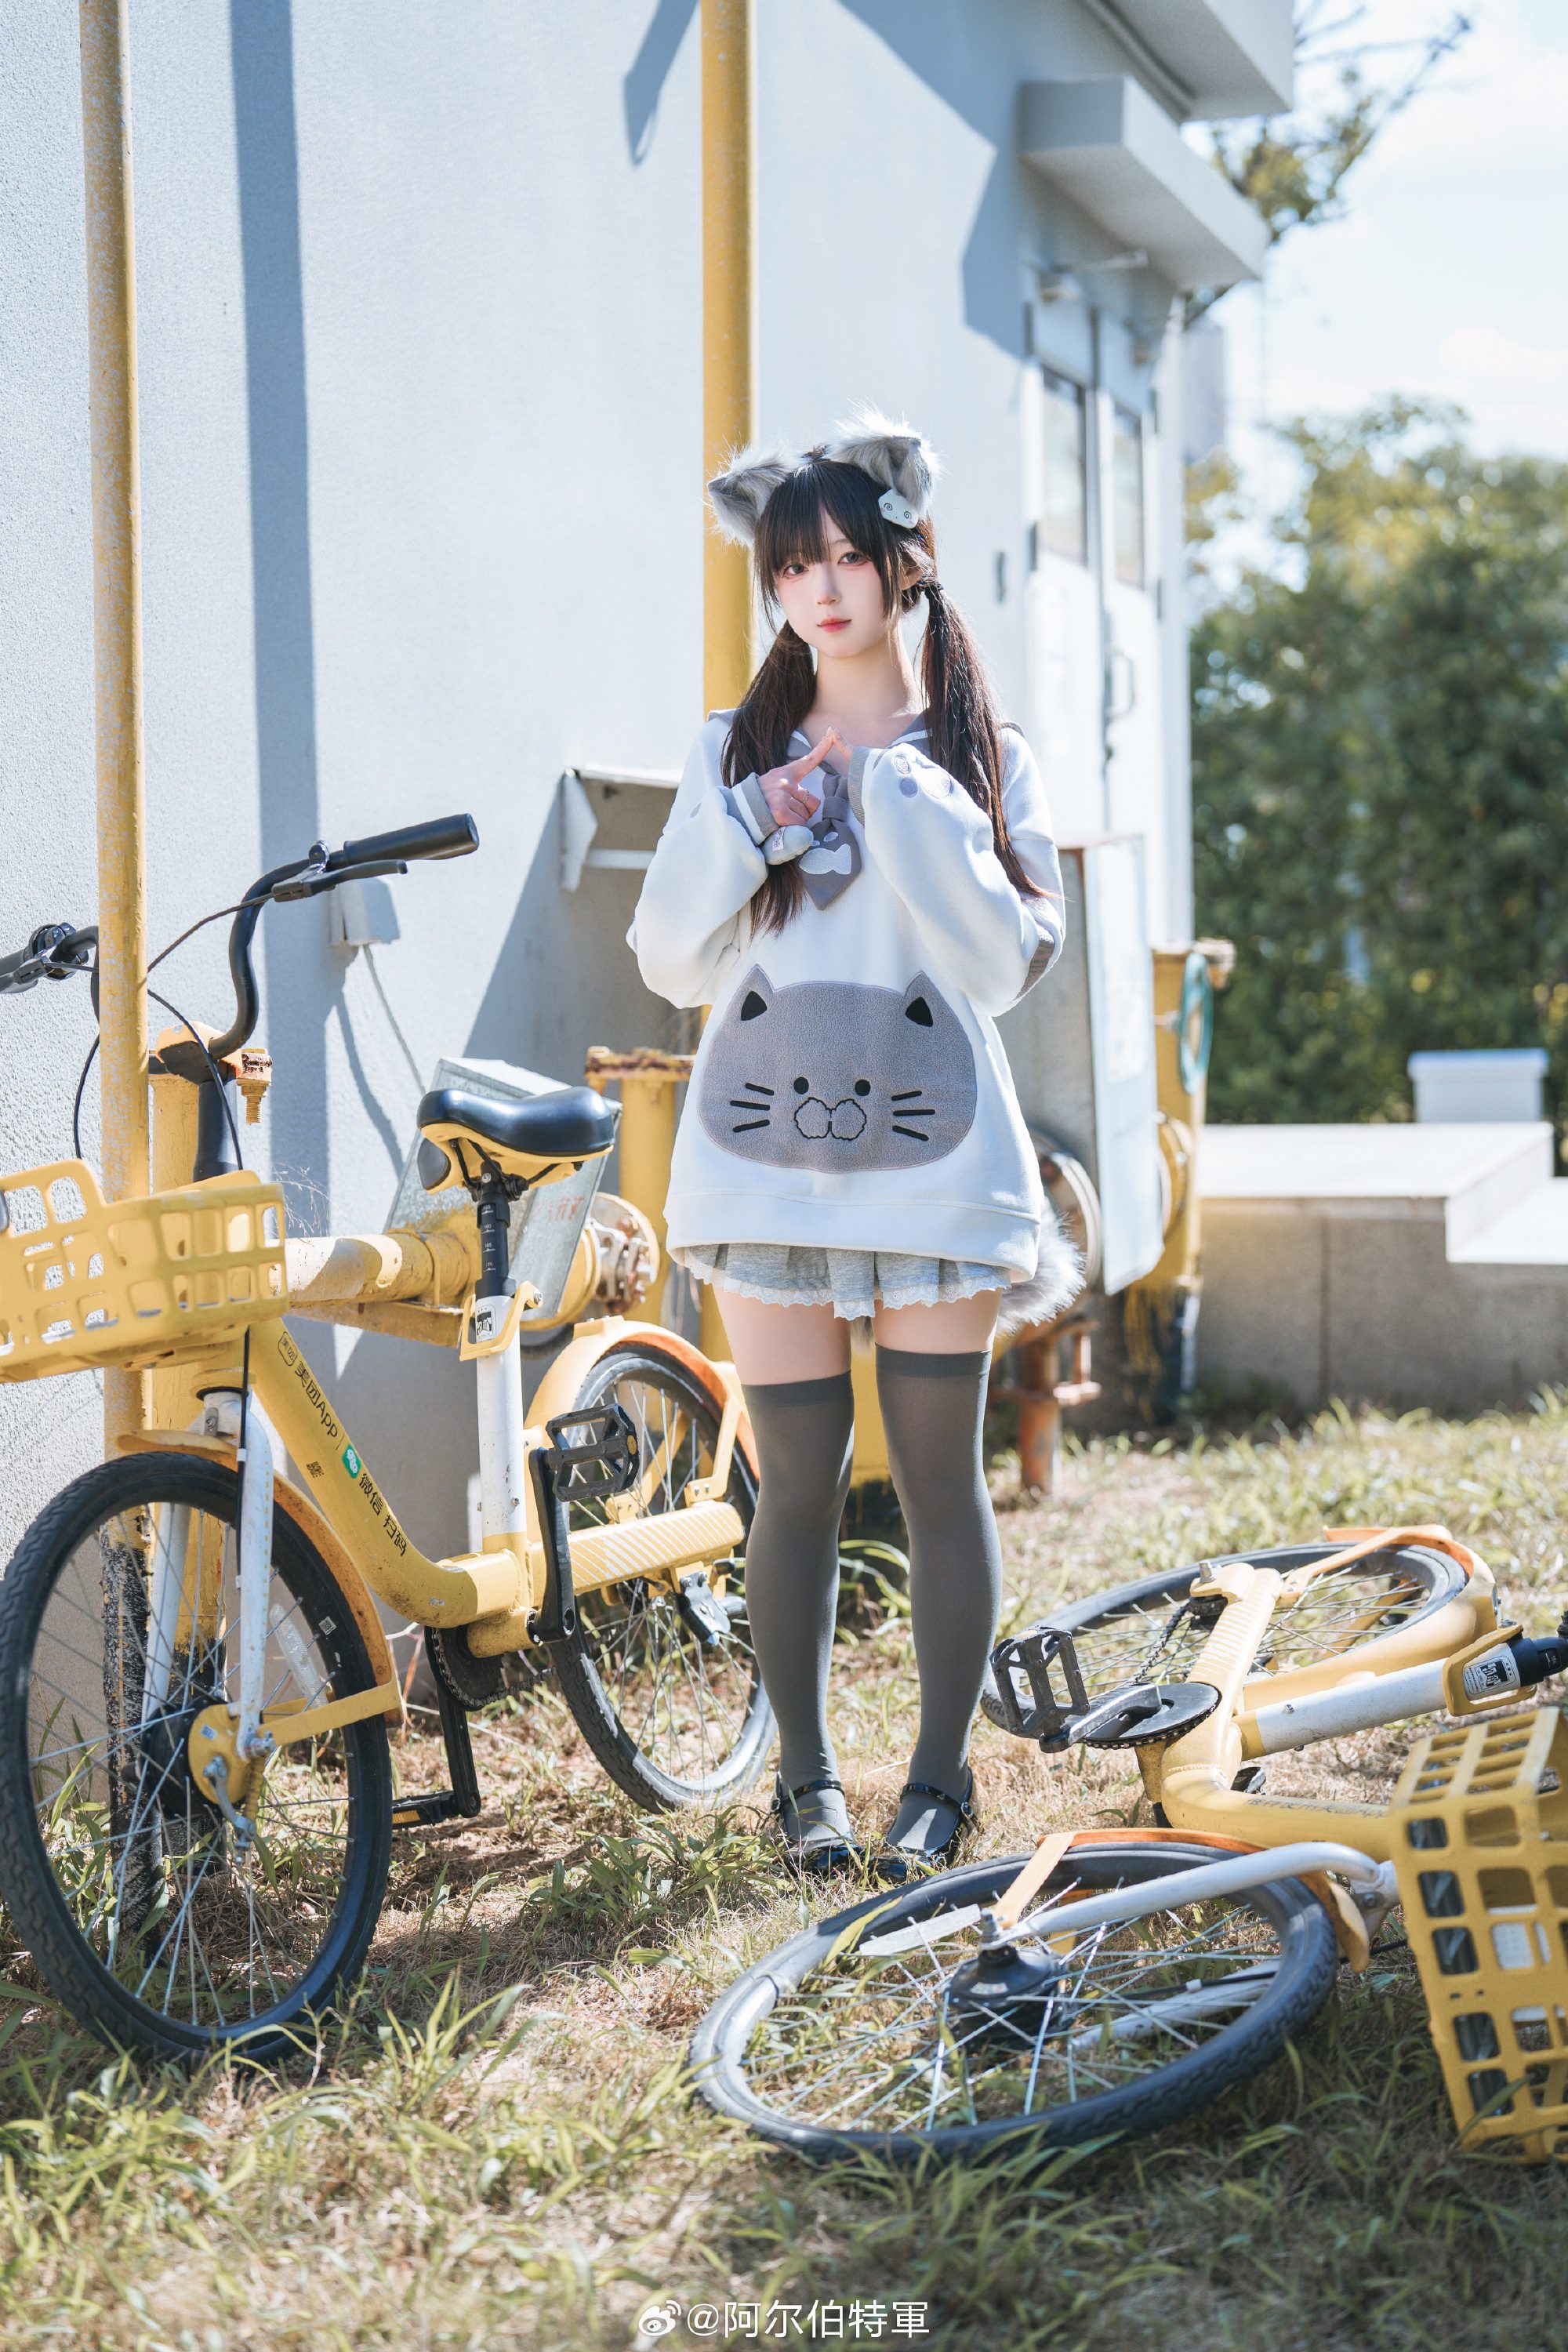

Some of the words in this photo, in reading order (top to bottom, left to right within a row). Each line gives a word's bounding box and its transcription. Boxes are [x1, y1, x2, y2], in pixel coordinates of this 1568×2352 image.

[281, 1337, 296, 1361] 美团
[294, 1360, 338, 1438] 美团App
[358, 1473, 384, 1516] 微信
[383, 1514, 407, 1556] 扫码
